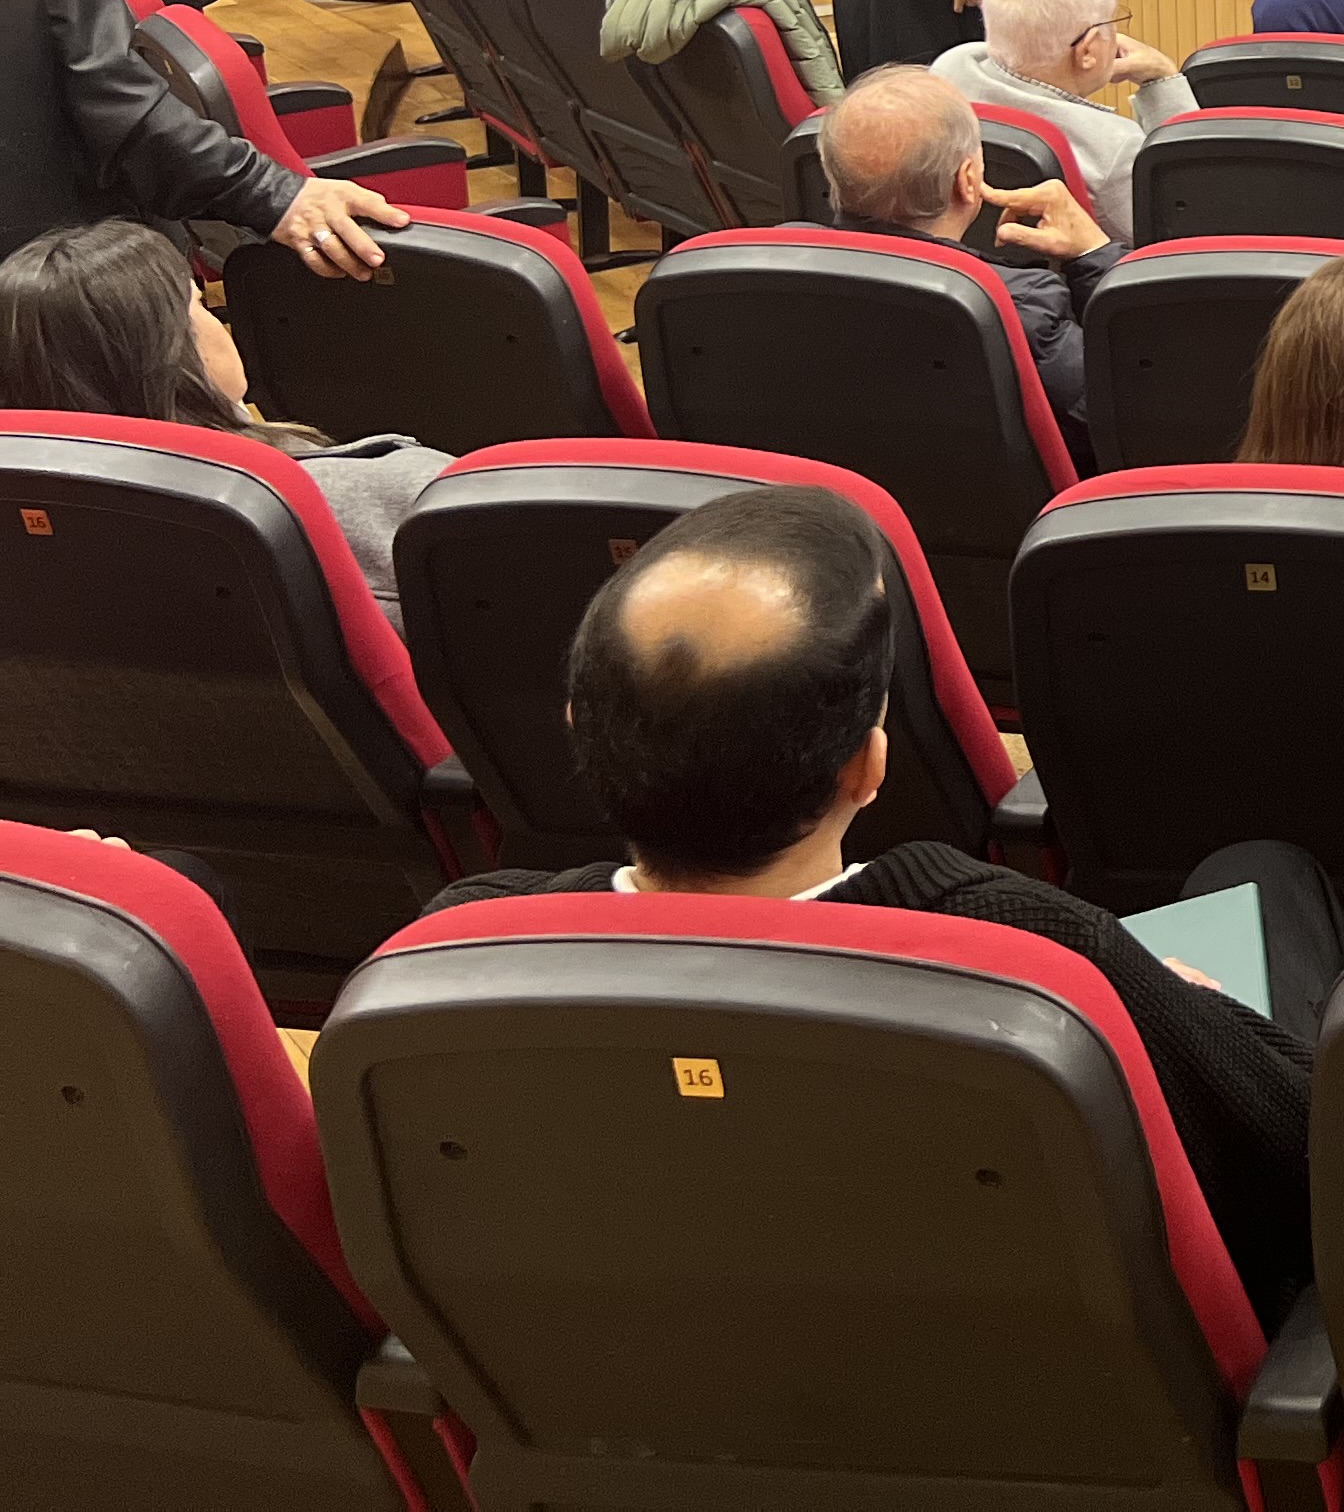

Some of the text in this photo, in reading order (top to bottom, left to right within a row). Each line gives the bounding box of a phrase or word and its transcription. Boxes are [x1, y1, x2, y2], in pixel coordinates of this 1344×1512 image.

[26, 517, 47, 528] 16
[1250, 571, 1269, 584] 14
[683, 1069, 714, 1086] 16
